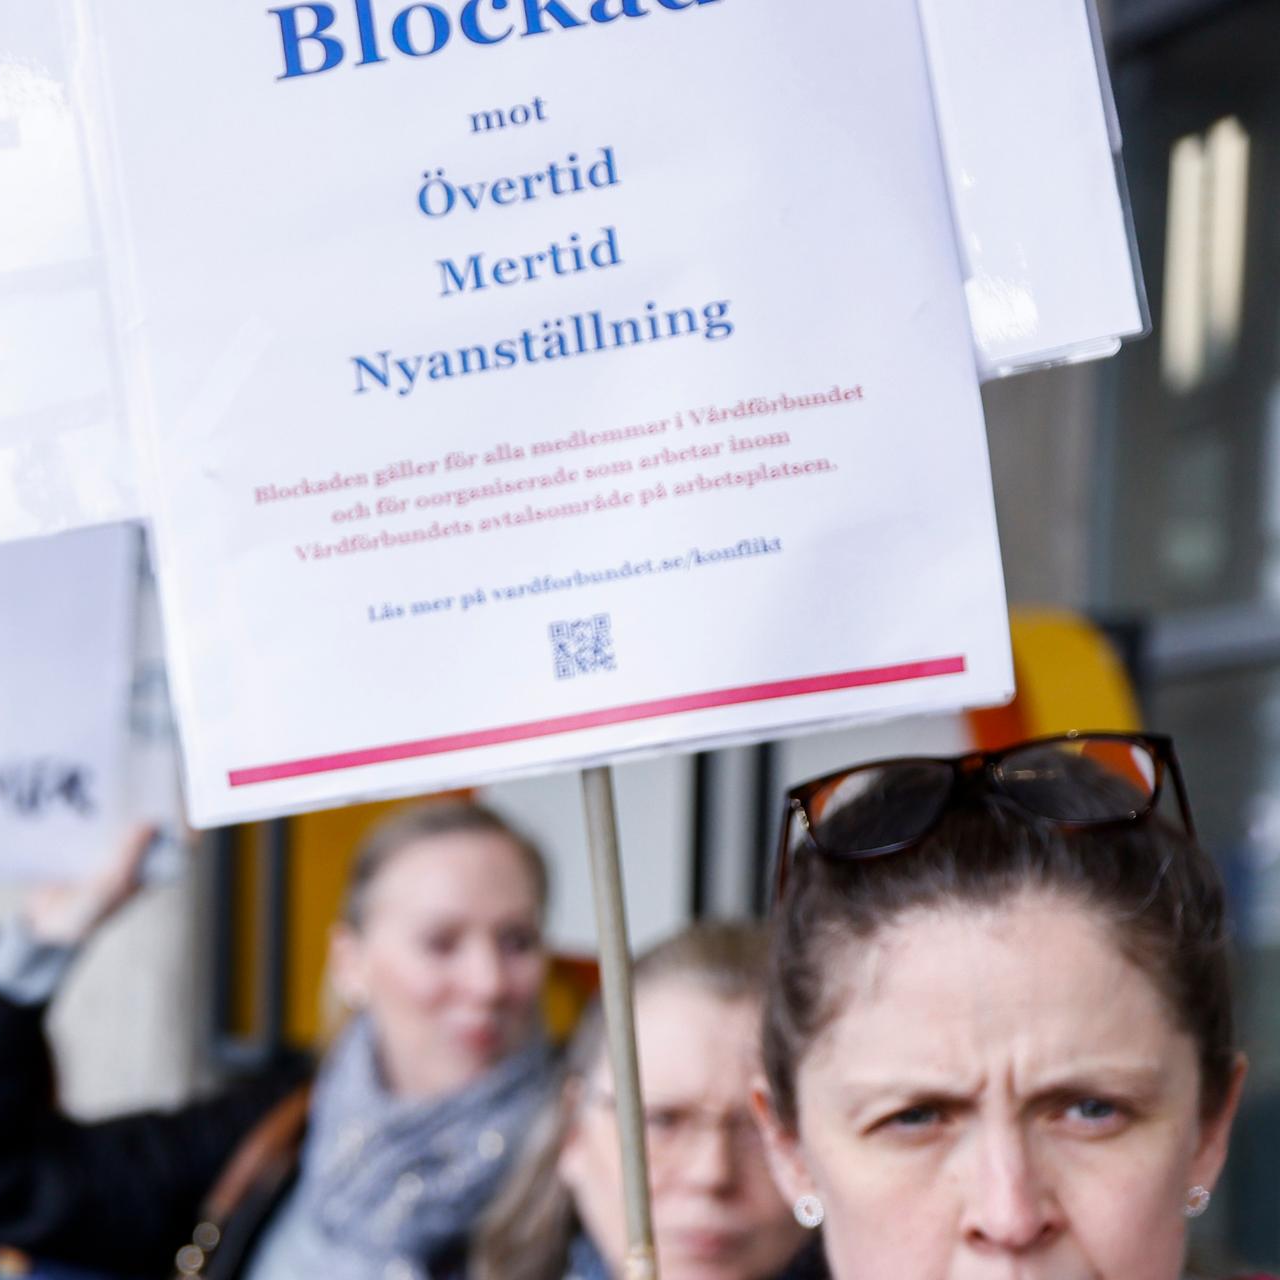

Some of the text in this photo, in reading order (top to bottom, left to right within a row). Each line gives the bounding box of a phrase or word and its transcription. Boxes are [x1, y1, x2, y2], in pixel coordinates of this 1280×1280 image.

[468, 96, 548, 134] mot
[416, 146, 620, 219] Övertid
[435, 226, 623, 298] Mertid
[349, 298, 735, 398] Nyanställning
[253, 470, 369, 505] Blockaden
[374, 459, 440, 489] gäller
[443, 450, 479, 472] för
[483, 442, 526, 467] alla
[530, 416, 672, 458] medlemmar
[688, 383, 865, 428] Vårdförbundet
[332, 430, 792, 525] och för oorganiserade som arbetar inom
[294, 455, 839, 562] Vårdförbundets avtalsområde på arbetsplatsen.
[367, 603, 406, 623] Läs
[410, 595, 456, 615] mer
[460, 587, 487, 612] på
